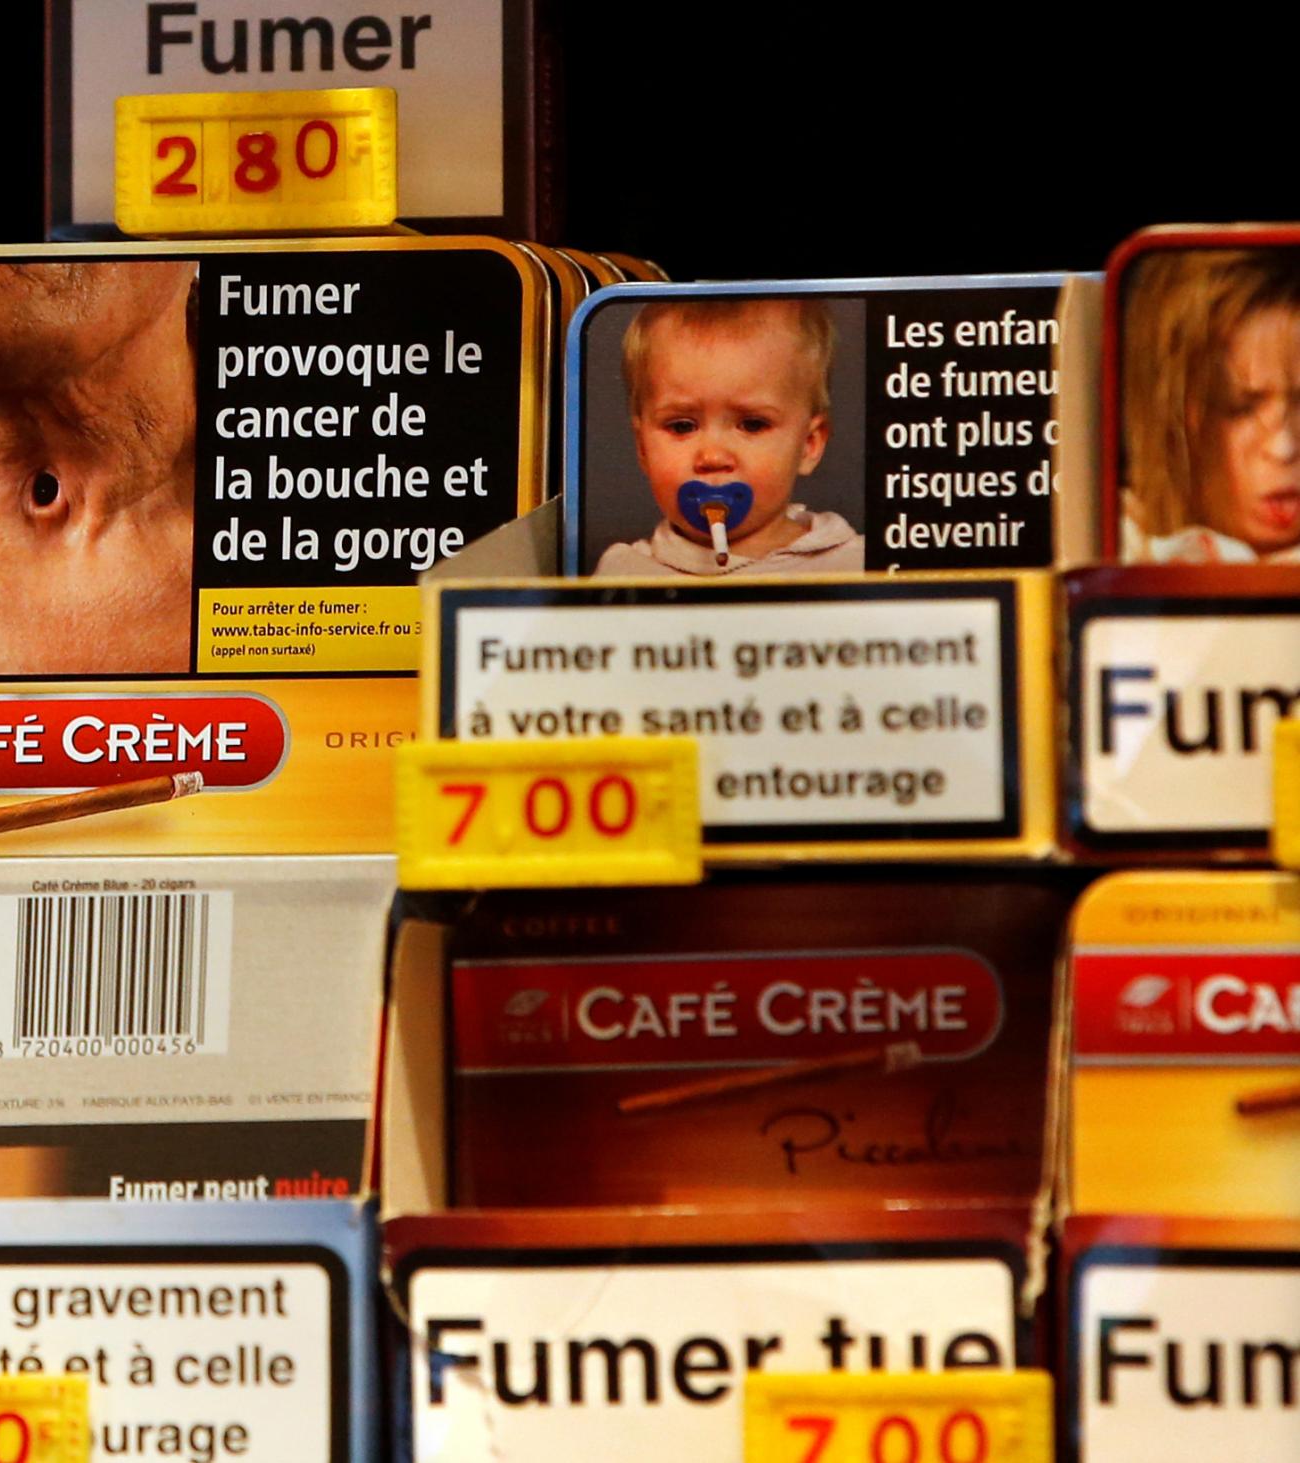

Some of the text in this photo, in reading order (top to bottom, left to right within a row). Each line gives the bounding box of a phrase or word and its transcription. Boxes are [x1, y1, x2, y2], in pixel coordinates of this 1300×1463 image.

[147, 2, 432, 74] Fumer
[220, 275, 360, 315] Fumer
[887, 310, 1059, 347] Les enfan
[217, 330, 482, 389] provoque le
[885, 361, 1059, 398] de fumeu
[215, 392, 426, 439] cancer de
[886, 417, 947, 448] ont
[957, 411, 1032, 455] plus
[214, 454, 488, 500] la bouche et
[886, 465, 1016, 505] risques
[212, 516, 464, 572] de la gorge
[885, 513, 1024, 548] devenir
[211, 621, 390, 638] www.tabac-info-service.fr
[393, 623, 411, 635] ou
[212, 600, 360, 616] Pour arrêter de fumer
[211, 642, 316, 658] (appel non surtaxé)
[478, 633, 977, 677] Fumer nuit gravement
[469, 698, 988, 736] à votre santé et à celle
[1098, 665, 1300, 755] Fum
[62, 713, 247, 763] CRÈME
[716, 766, 944, 807] entourage
[32, 878, 196, 892] Café Crème Blue 20 cigars
[577, 982, 738, 1041] CAFÉ
[757, 976, 967, 1035] CRÈME
[22, 1038, 102, 1058] 720400
[114, 1037, 196, 1057] 000456
[110, 1170, 349, 1200] Fumer peut nuire
[13, 1277, 288, 1328] gravement
[65, 1351, 110, 1385] et
[130, 1344, 155, 1386] à
[174, 1347, 294, 1386] celle
[427, 1317, 781, 1407] Fumer
[1098, 1316, 1300, 1408] Fum
[88, 1416, 247, 1463] urage
